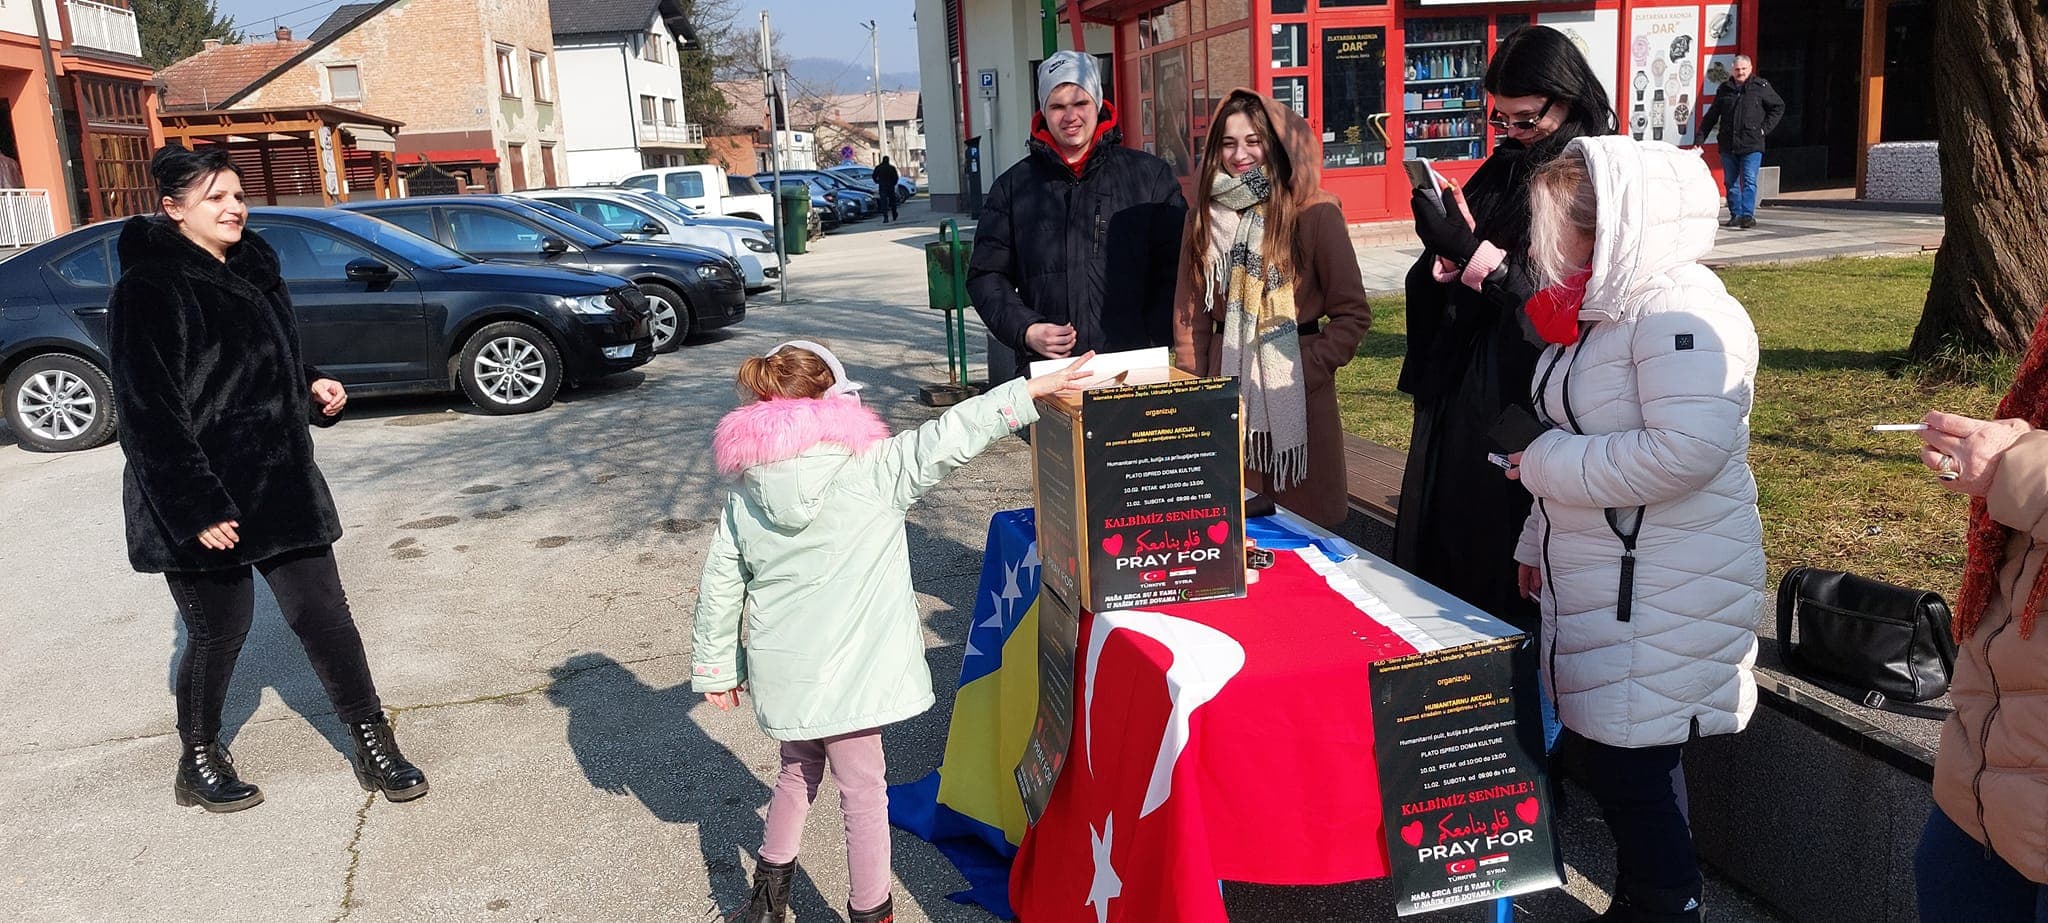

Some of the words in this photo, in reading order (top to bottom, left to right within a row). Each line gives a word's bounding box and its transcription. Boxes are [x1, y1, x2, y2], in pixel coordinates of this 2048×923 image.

[984, 75, 991, 84] P
[1146, 408, 1176, 416] organizuju
[1132, 428, 1174, 439] HUMANITARNU
[1174, 426, 1196, 434] AKCIJU
[1106, 459, 1137, 467] Humanitarni
[1171, 452, 1199, 461] prikupljanje
[1143, 470, 1162, 478] ISPRED
[1162, 468, 1178, 476] DOMA
[1178, 466, 1201, 474] KULTURE
[1141, 484, 1158, 492] PETAK
[1144, 498, 1165, 506] SUBOTA
[1105, 514, 1164, 529] KALBİMİZ
[1166, 508, 1220, 522] SENİNLE
[1116, 553, 1172, 570] PRAY
[1178, 548, 1220, 563] FOR
[1437, 674, 1471, 686] organizuju
[1424, 697, 1469, 712] HUMANITARNU
[1470, 692, 1492, 703] AKCIJU
[1399, 735, 1433, 746] Humanitarni
[1434, 732, 1447, 740] pult,
[1446, 729, 1461, 738] kutija
[1469, 723, 1499, 734] prikupljanje
[1420, 749, 1439, 758] PLATO
[1439, 746, 1459, 755] ISPRED
[1460, 742, 1478, 751] DOMA
[1478, 737, 1503, 747] KULTURE
[1439, 762, 1457, 771] PETAK
[1443, 776, 1466, 786] SUBOTA
[1401, 794, 1466, 816] KALBİMİZ
[1469, 782, 1527, 803] SENİNLE
[1418, 839, 1479, 862] PRAY
[1486, 829, 1533, 849] FOR
[1486, 867, 1506, 876] SYRIA
[1411, 890, 1430, 901] NAŠA
[1432, 888, 1451, 898] SRCA
[1471, 882, 1491, 890] VAMA
